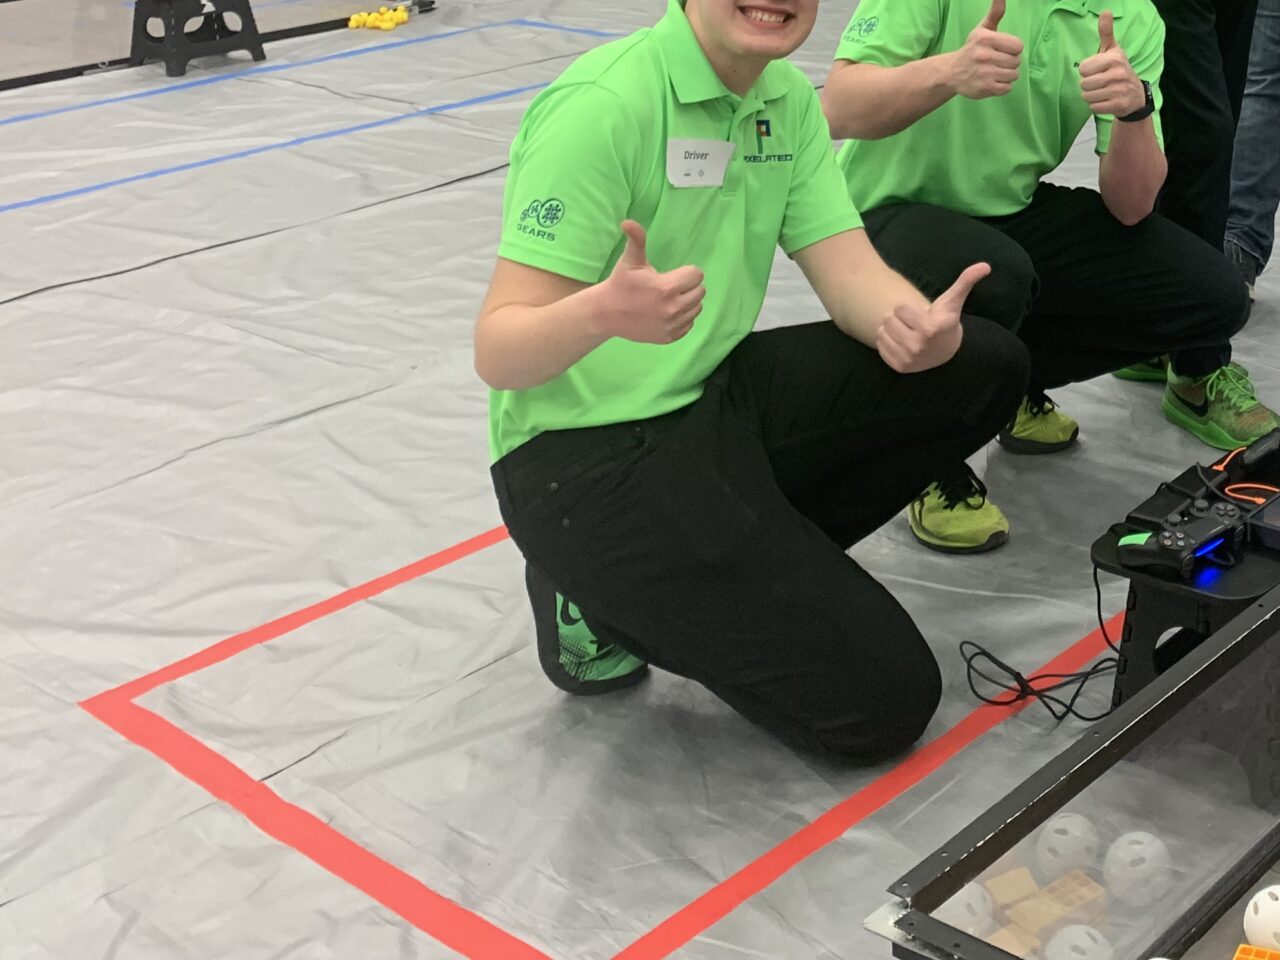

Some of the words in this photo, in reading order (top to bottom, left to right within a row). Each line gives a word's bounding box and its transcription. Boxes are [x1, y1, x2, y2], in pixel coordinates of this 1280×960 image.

[683, 149, 709, 160] Driver
[743, 153, 793, 163] XELATED
[516, 223, 555, 242] GEARS
